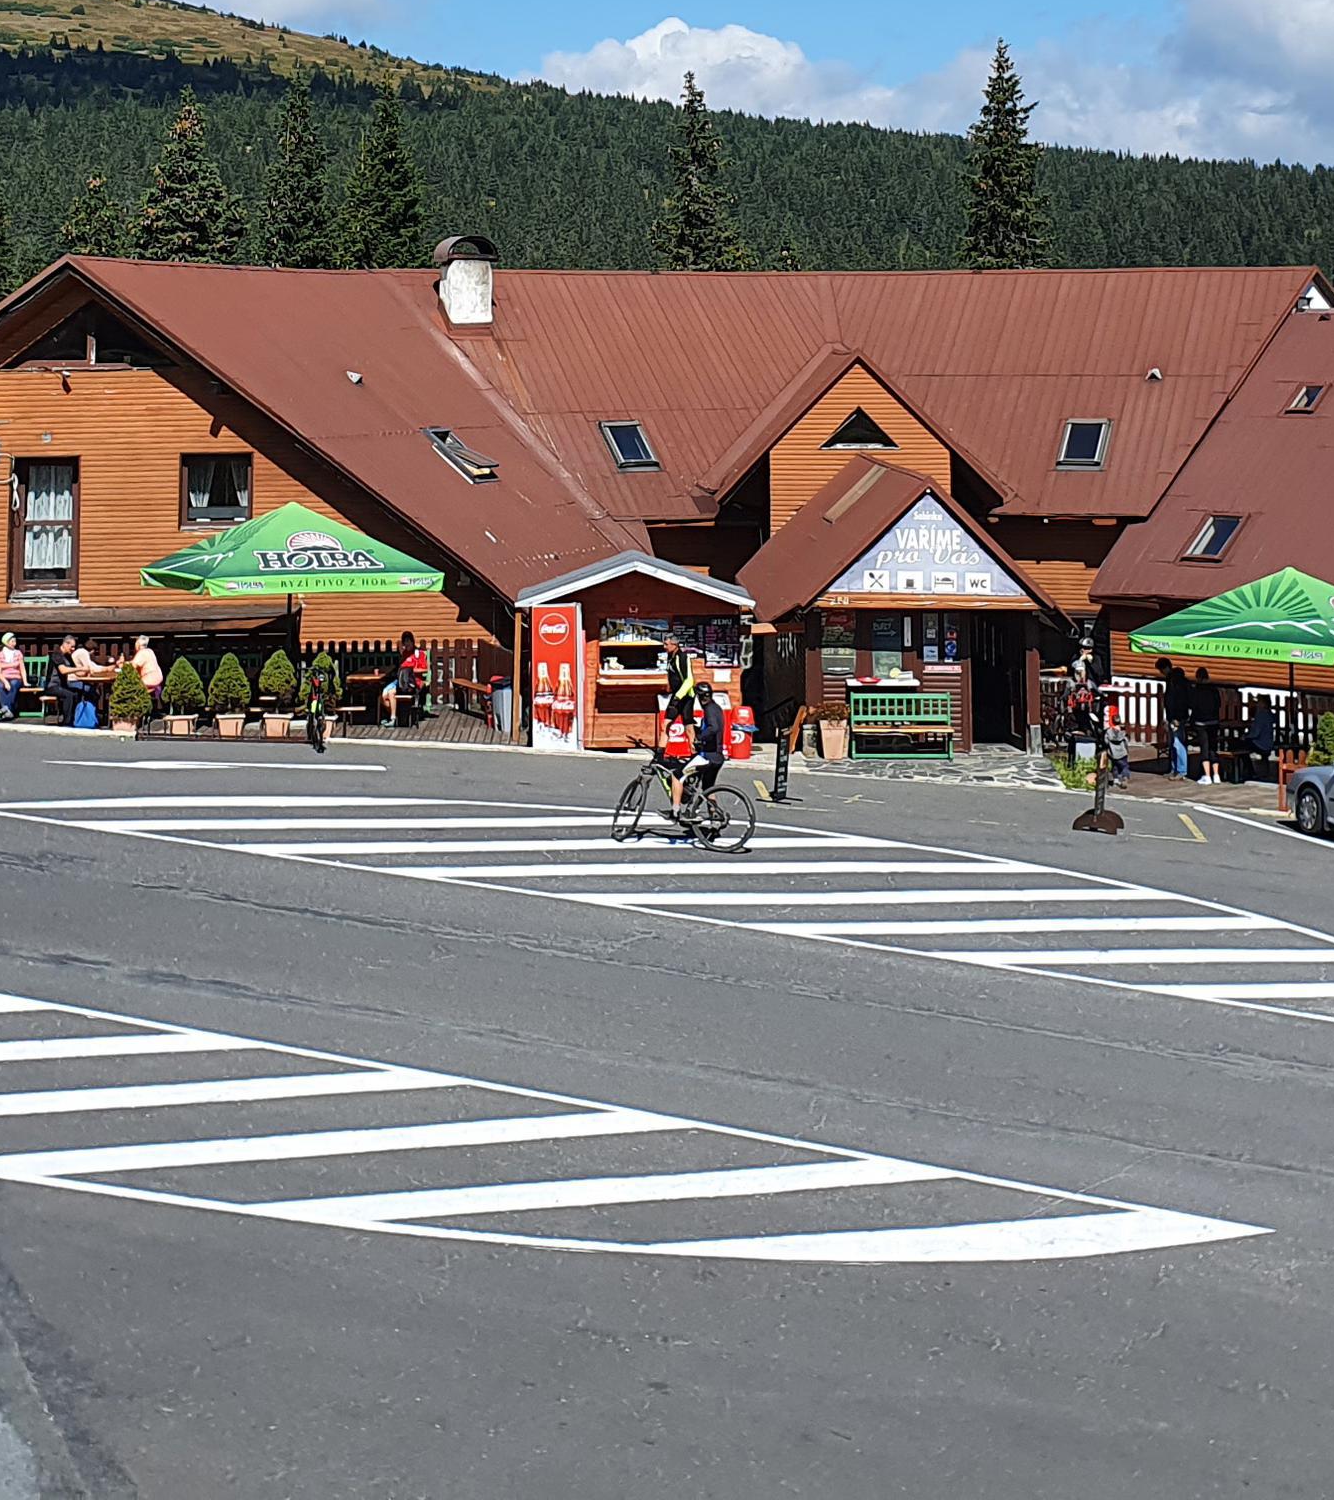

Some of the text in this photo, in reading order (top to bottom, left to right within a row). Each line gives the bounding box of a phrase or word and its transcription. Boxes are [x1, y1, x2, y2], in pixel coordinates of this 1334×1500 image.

[895, 524, 962, 550] VAŘÍME
[253, 549, 385, 571] HOLBA
[876, 545, 981, 569] pro Vás
[280, 577, 388, 589] RYZÍ PIVO Z HOR
[968, 578, 988, 589] WC
[1214, 643, 1241, 654] PIVO
